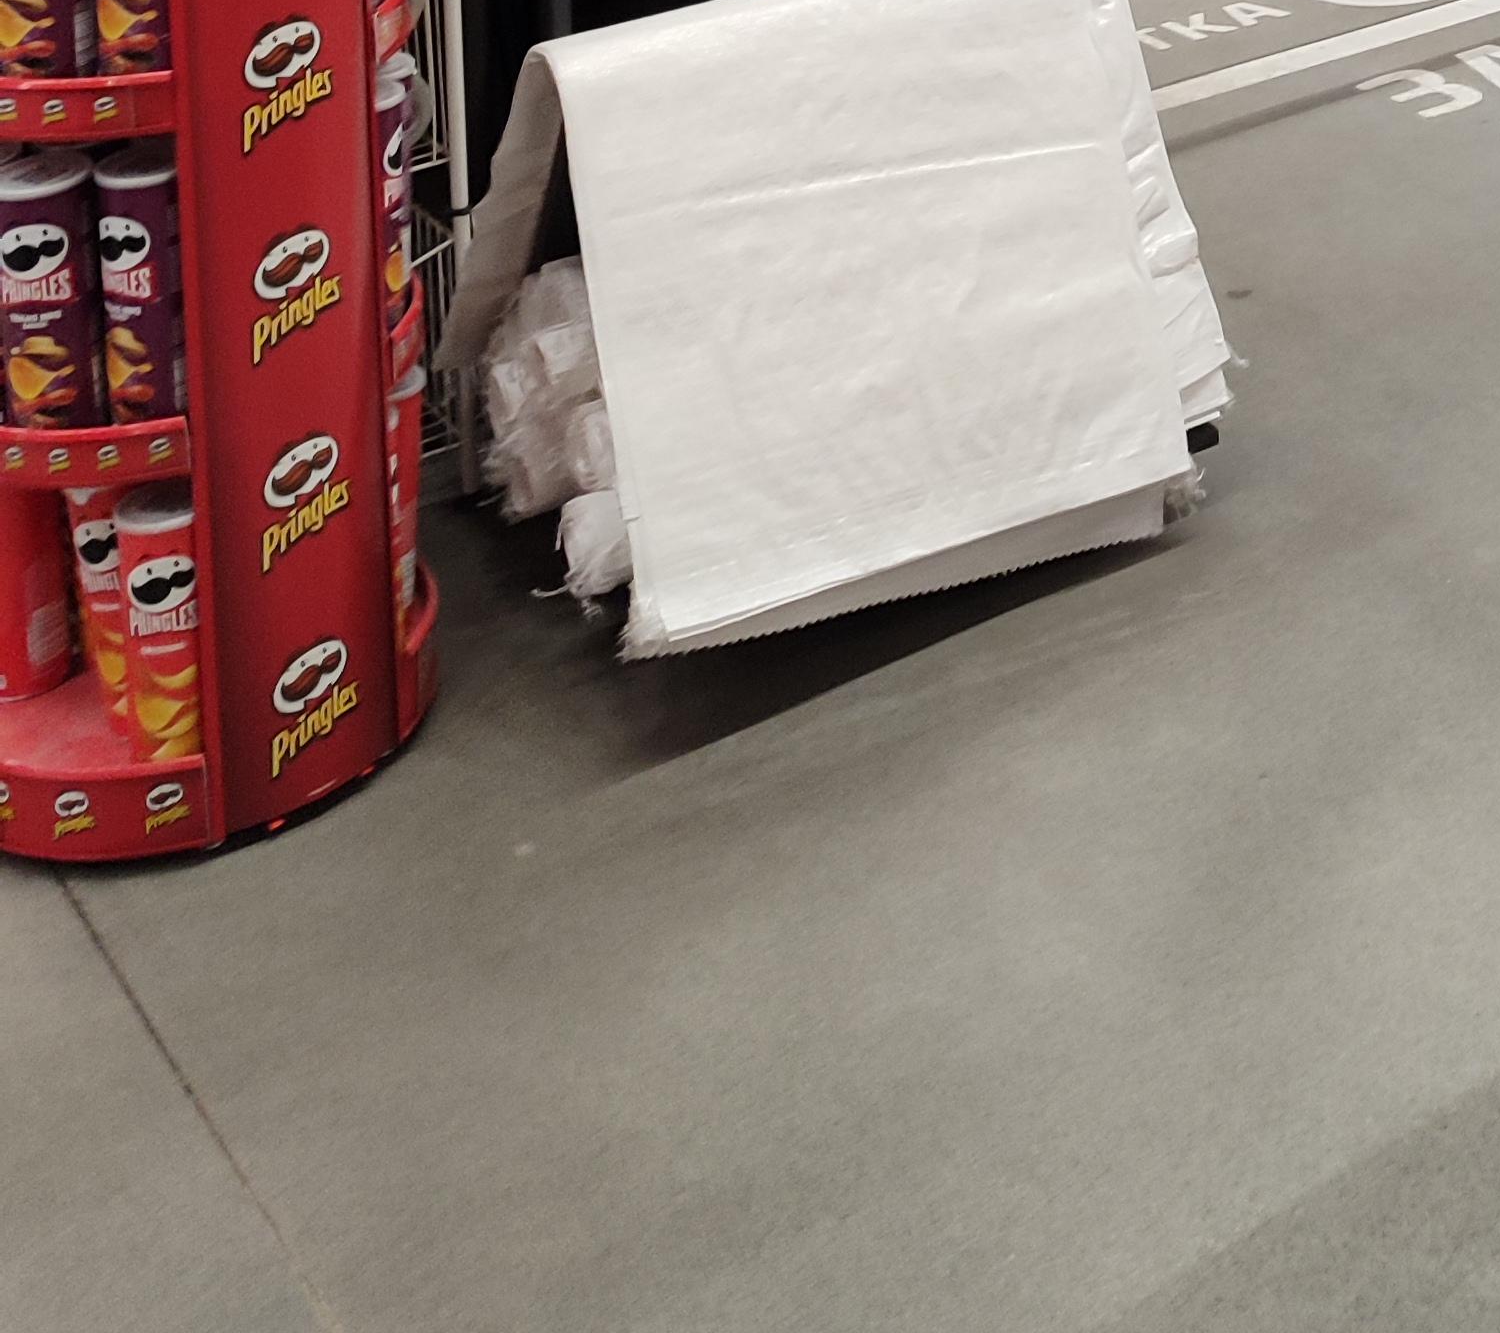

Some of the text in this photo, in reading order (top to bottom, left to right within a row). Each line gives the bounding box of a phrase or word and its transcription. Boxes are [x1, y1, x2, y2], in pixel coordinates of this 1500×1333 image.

[243, 68, 332, 154] Pringles
[253, 276, 342, 365] Pringles
[262, 480, 350, 573] Pringles
[271, 682, 359, 779] Pringles
